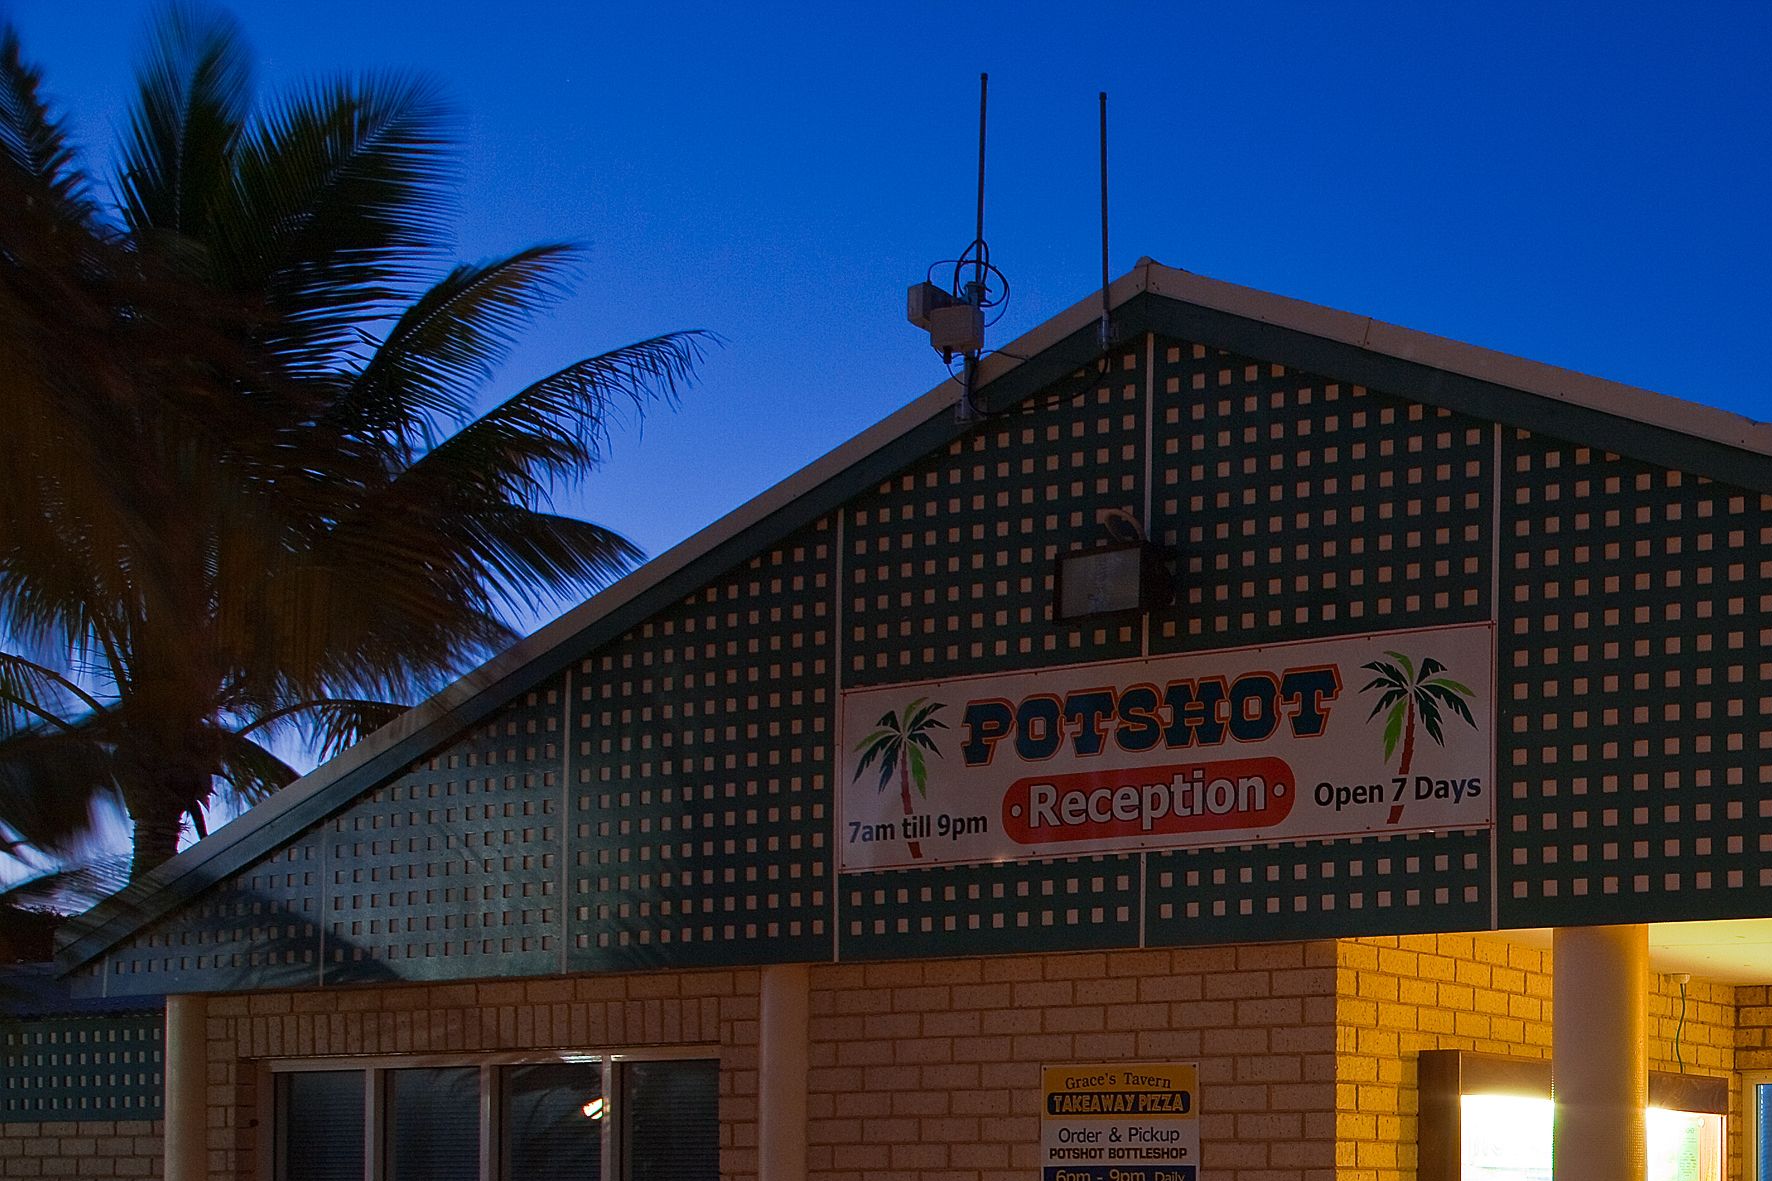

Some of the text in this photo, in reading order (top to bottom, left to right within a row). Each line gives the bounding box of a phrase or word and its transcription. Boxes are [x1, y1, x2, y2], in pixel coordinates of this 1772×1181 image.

[961, 664, 1343, 767] POTSHOT
[1028, 769, 1267, 830] Reception
[1314, 776, 1481, 811] Open 7 Days
[849, 813, 988, 844] 7am till 9pm
[1065, 1072, 1171, 1089] Grace's Tavern
[1053, 1093, 1184, 1112] TAKEAWAY PIZZA
[1058, 1127, 1180, 1144] Order & Pickup
[1050, 1147, 1187, 1159] POTSHOT BOTTLESHOP
